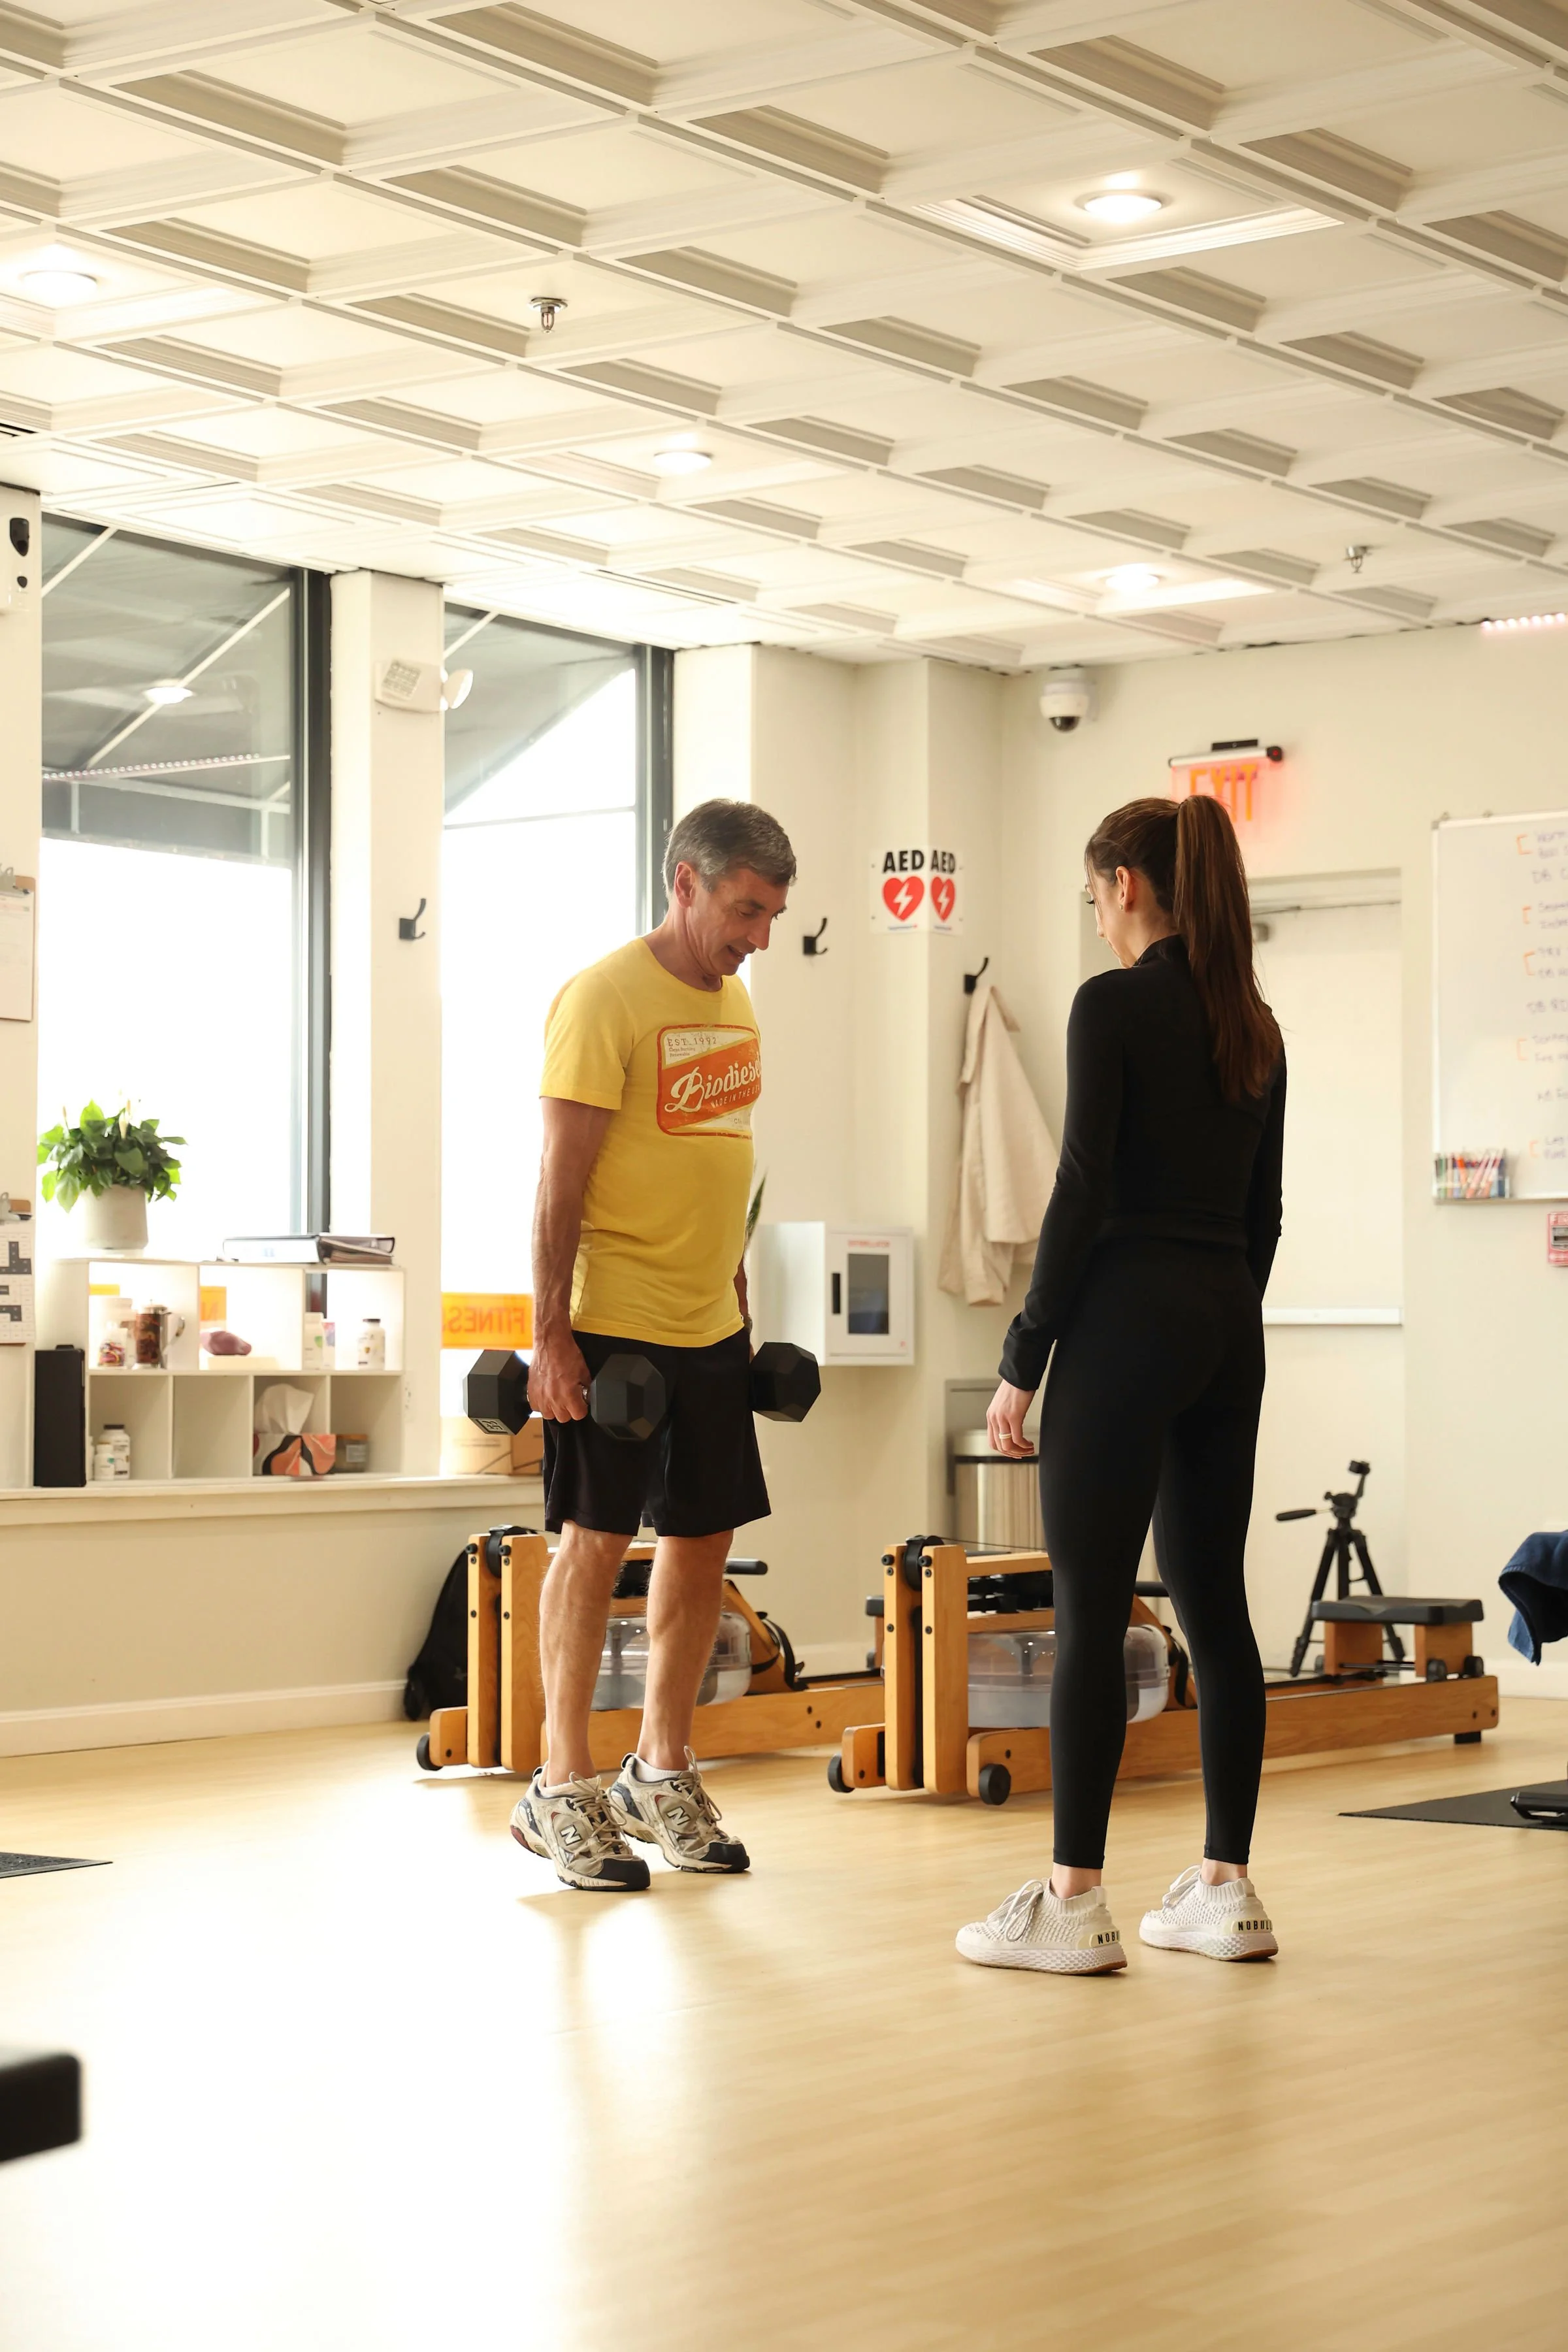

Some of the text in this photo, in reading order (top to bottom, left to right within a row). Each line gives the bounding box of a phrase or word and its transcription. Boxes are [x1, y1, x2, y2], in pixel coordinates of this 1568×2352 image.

[883, 849, 925, 874] AED
[930, 849, 956, 874] AED
[694, 1037, 717, 1045] 1992
[710, 1096, 728, 1109] MADE
[728, 1094, 738, 1103] IN
[738, 1088, 751, 1100] THE
[1238, 1920, 1272, 1931] NOBULL
